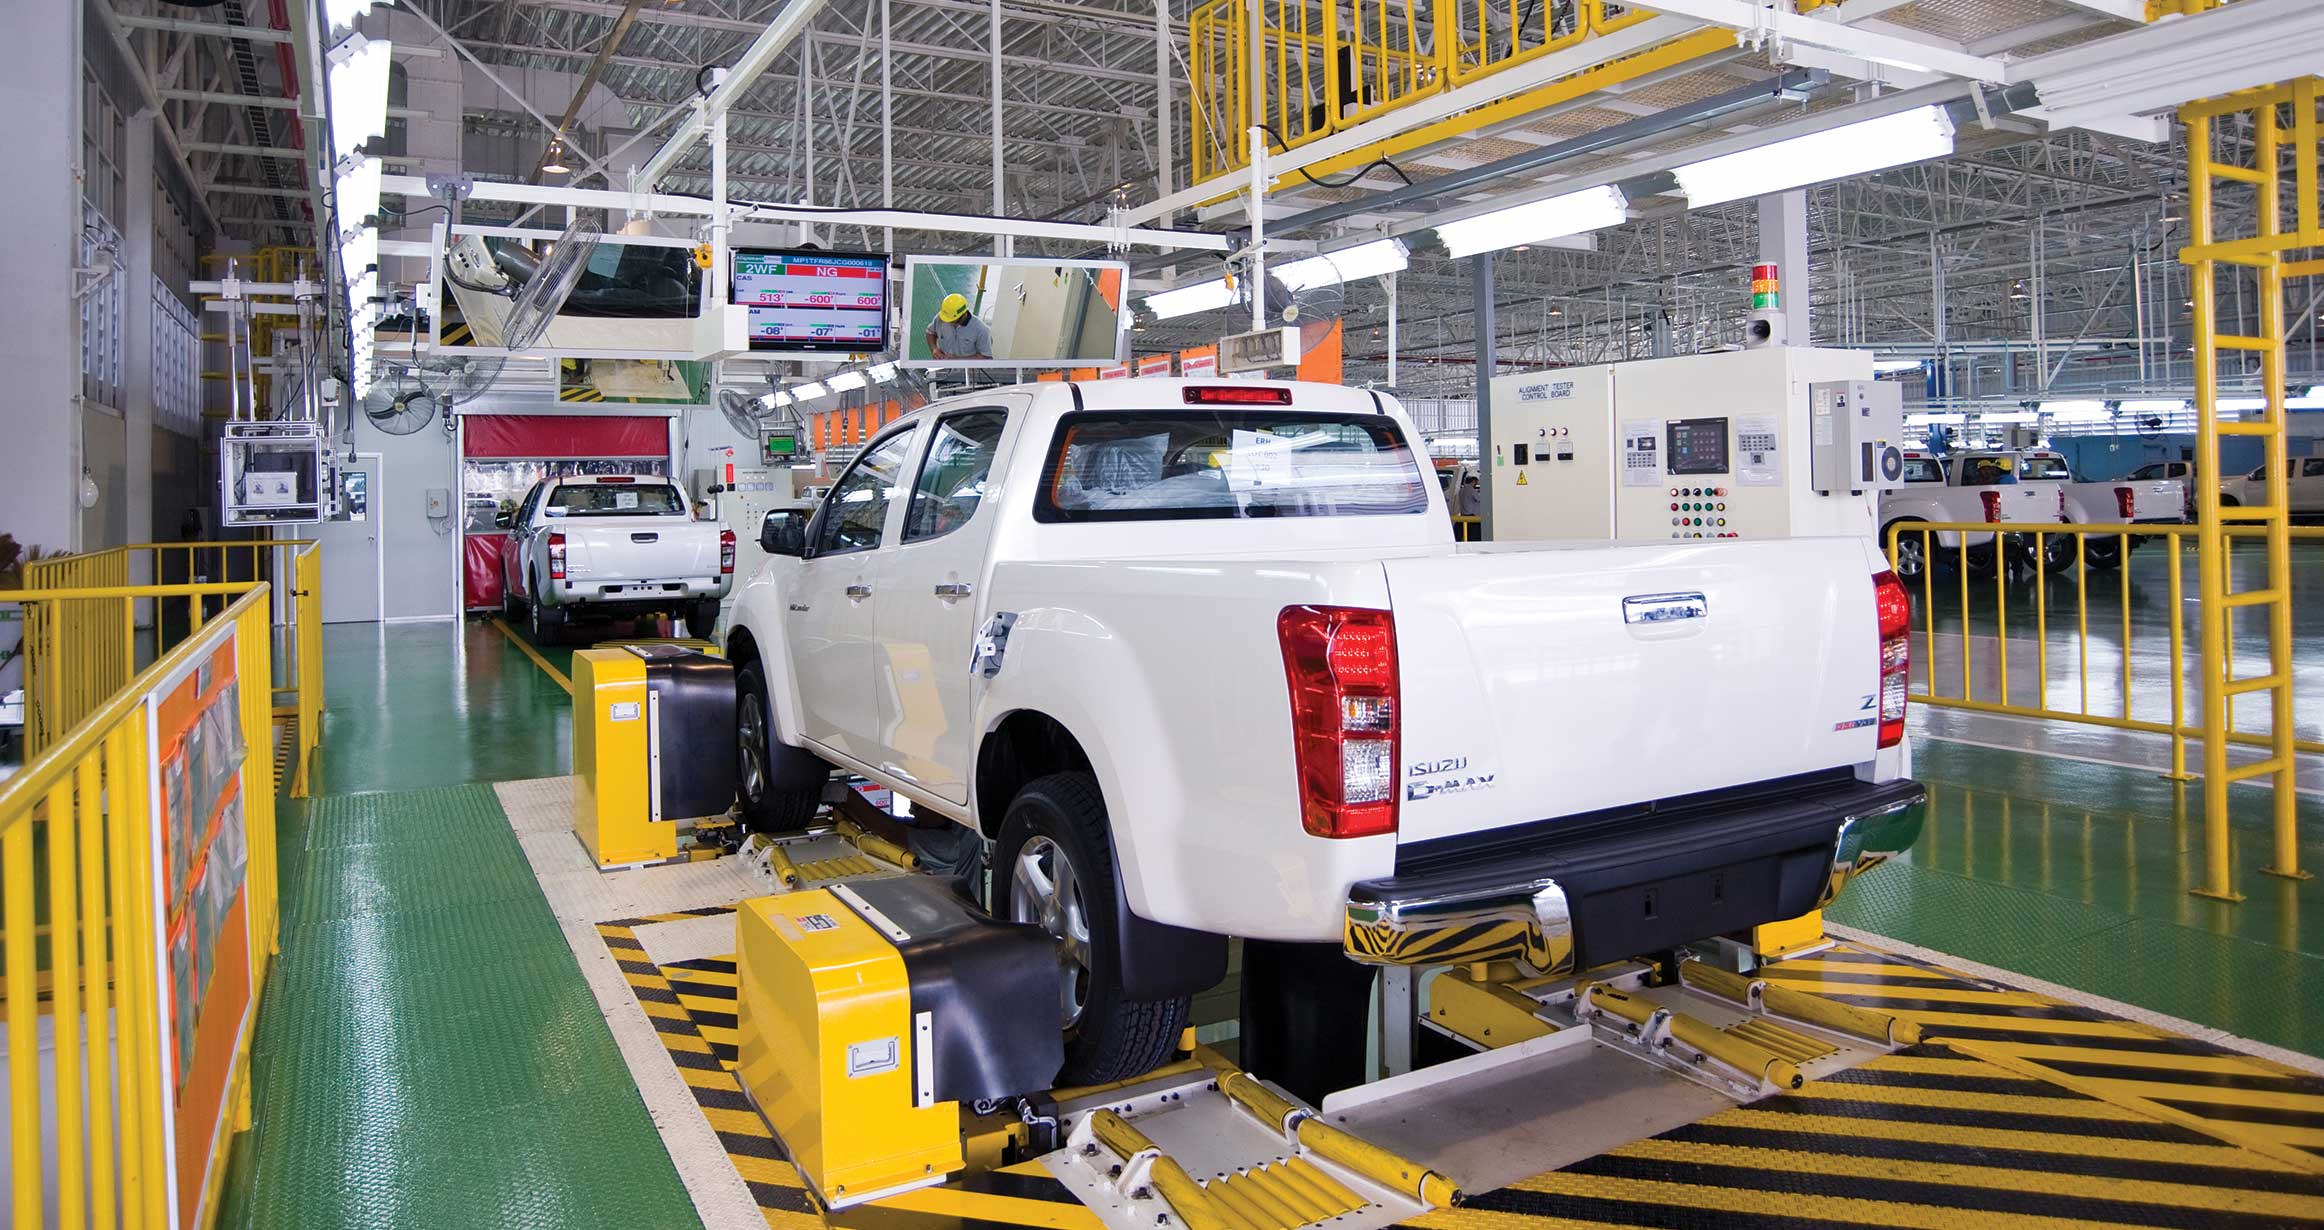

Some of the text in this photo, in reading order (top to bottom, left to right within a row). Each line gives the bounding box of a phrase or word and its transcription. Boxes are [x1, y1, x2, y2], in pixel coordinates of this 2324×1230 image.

[746, 264, 777, 274] 2WF
[816, 267, 838, 277] NG
[1518, 381, 1574, 393] ALIGNMENT TESTER
[1521, 390, 1571, 400] CONTROL BOARD
[1860, 694, 1877, 710] Z
[1409, 756, 1467, 777] ISUZU
